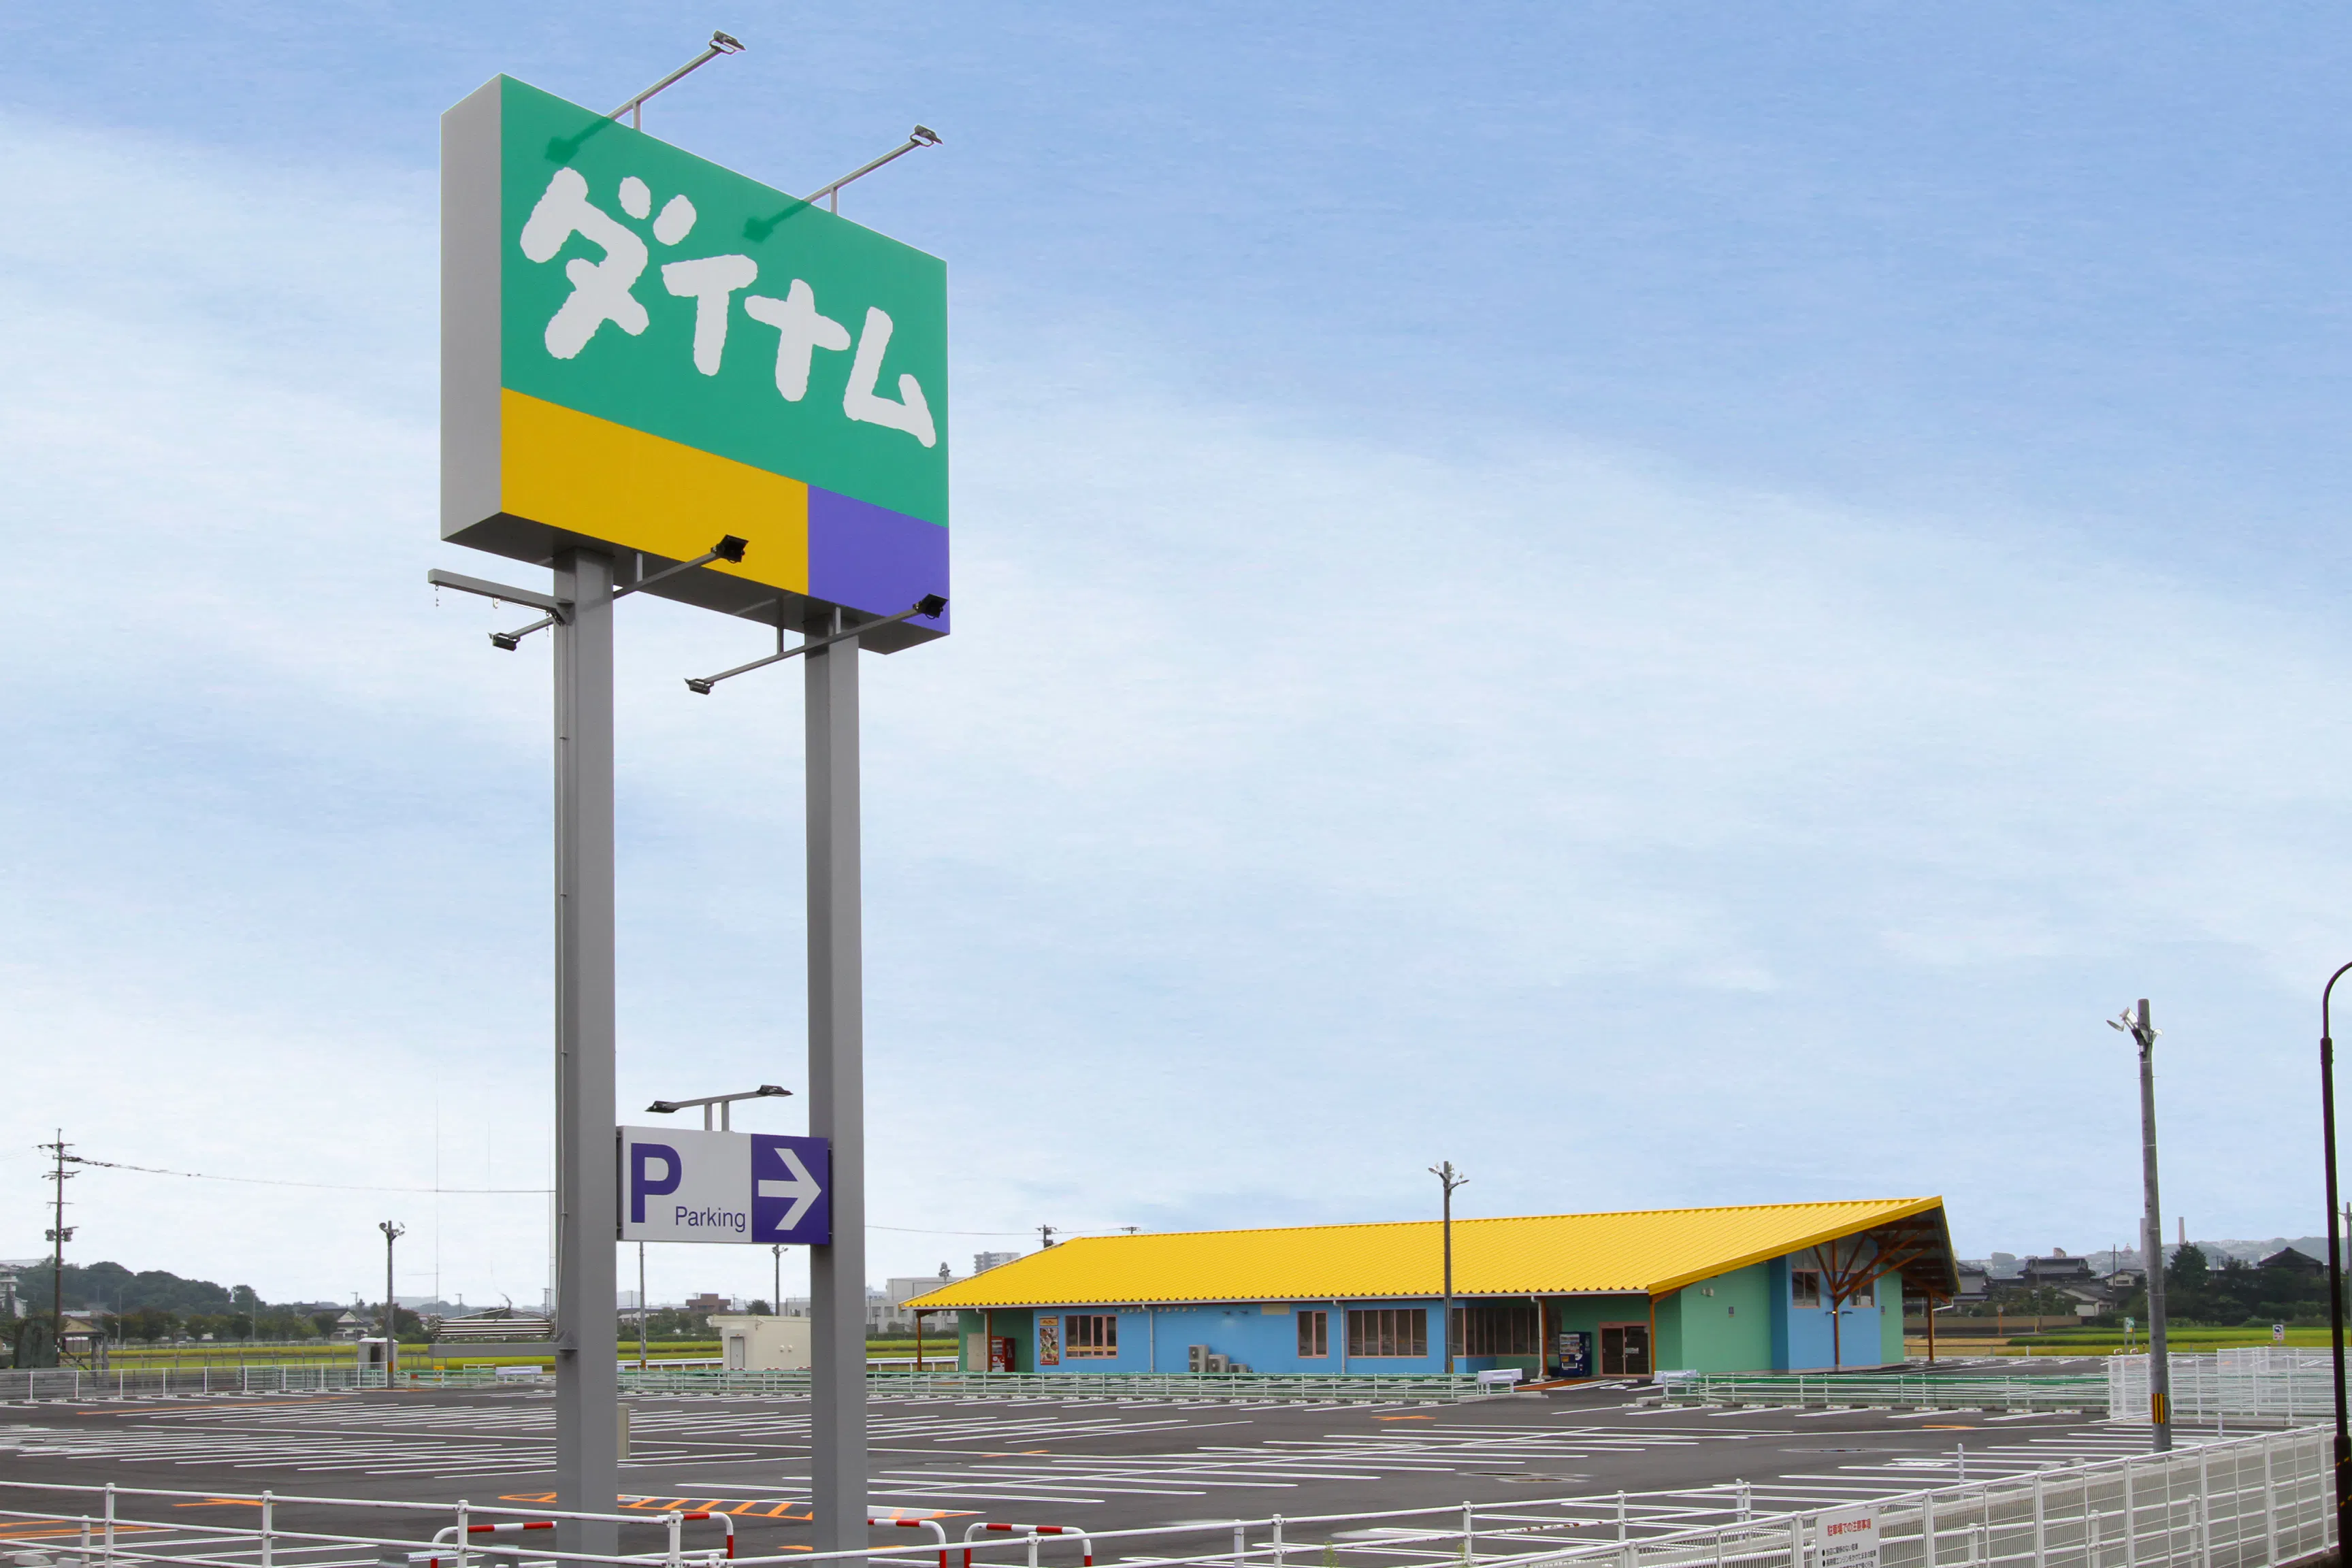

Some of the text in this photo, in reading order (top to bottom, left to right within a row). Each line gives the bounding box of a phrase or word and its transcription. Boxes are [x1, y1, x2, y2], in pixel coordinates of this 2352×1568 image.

[520, 167, 936, 448] ダイナム
[631, 1143, 682, 1223] P
[676, 1206, 746, 1232] Parking
[1827, 1518, 1872, 1536] 駐車場での注意事項
